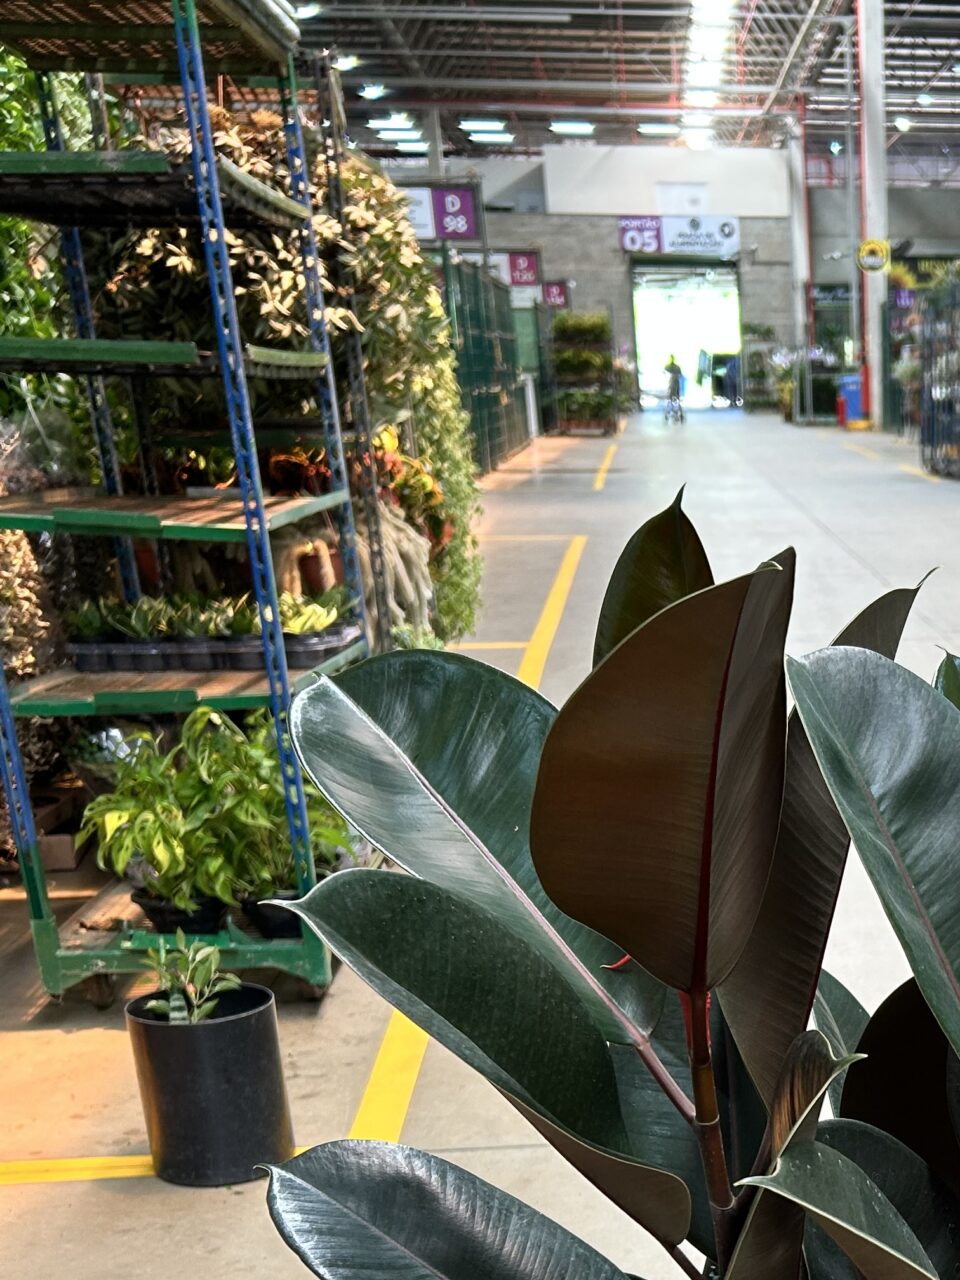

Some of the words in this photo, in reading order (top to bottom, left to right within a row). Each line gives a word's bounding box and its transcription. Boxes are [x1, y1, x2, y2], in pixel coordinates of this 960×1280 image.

[445, 194, 461, 213] D
[443, 215, 468, 233] 98
[623, 229, 658, 253] 05
